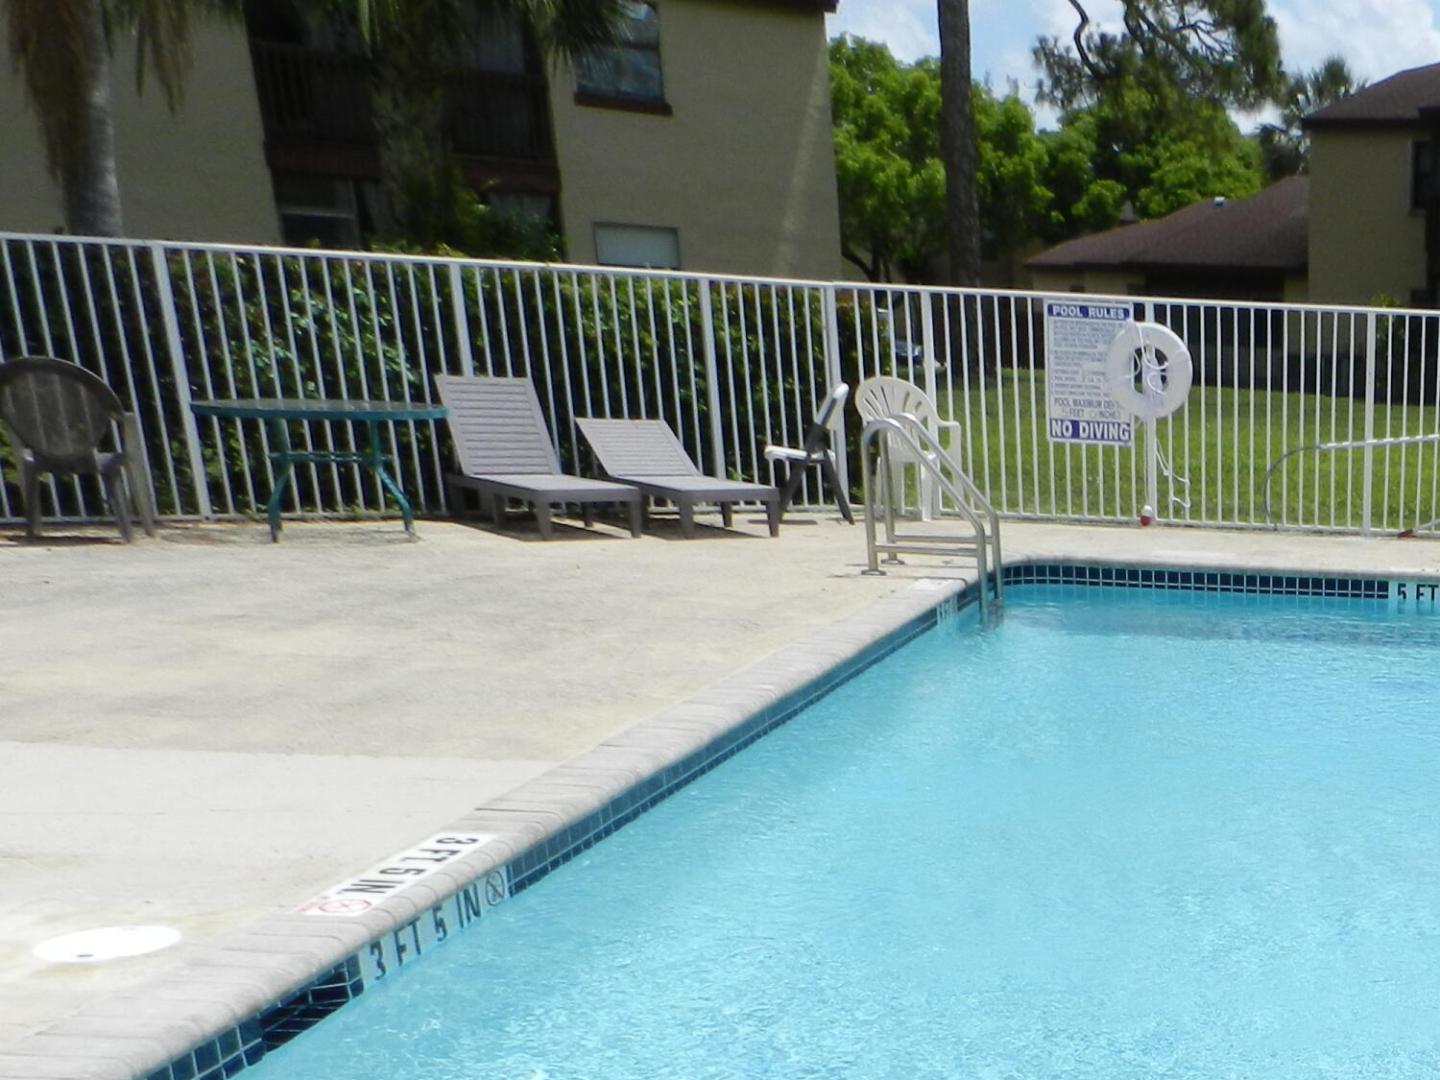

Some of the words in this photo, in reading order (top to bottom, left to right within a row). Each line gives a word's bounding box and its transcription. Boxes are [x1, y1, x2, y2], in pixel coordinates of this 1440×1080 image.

[1053, 305, 1083, 317] POOL
[1088, 307, 1124, 320] RULES
[1051, 419, 1073, 437] NO
[1079, 421, 1130, 441] DIVING
[1397, 583, 1407, 600] 5
[1416, 584, 1439, 601] FT
[436, 837, 479, 846] 3
[378, 867, 427, 876] 5
[369, 940, 387, 981] 3
[393, 917, 422, 967] FT
[432, 902, 448, 942] 5
[455, 882, 482, 929] IN
